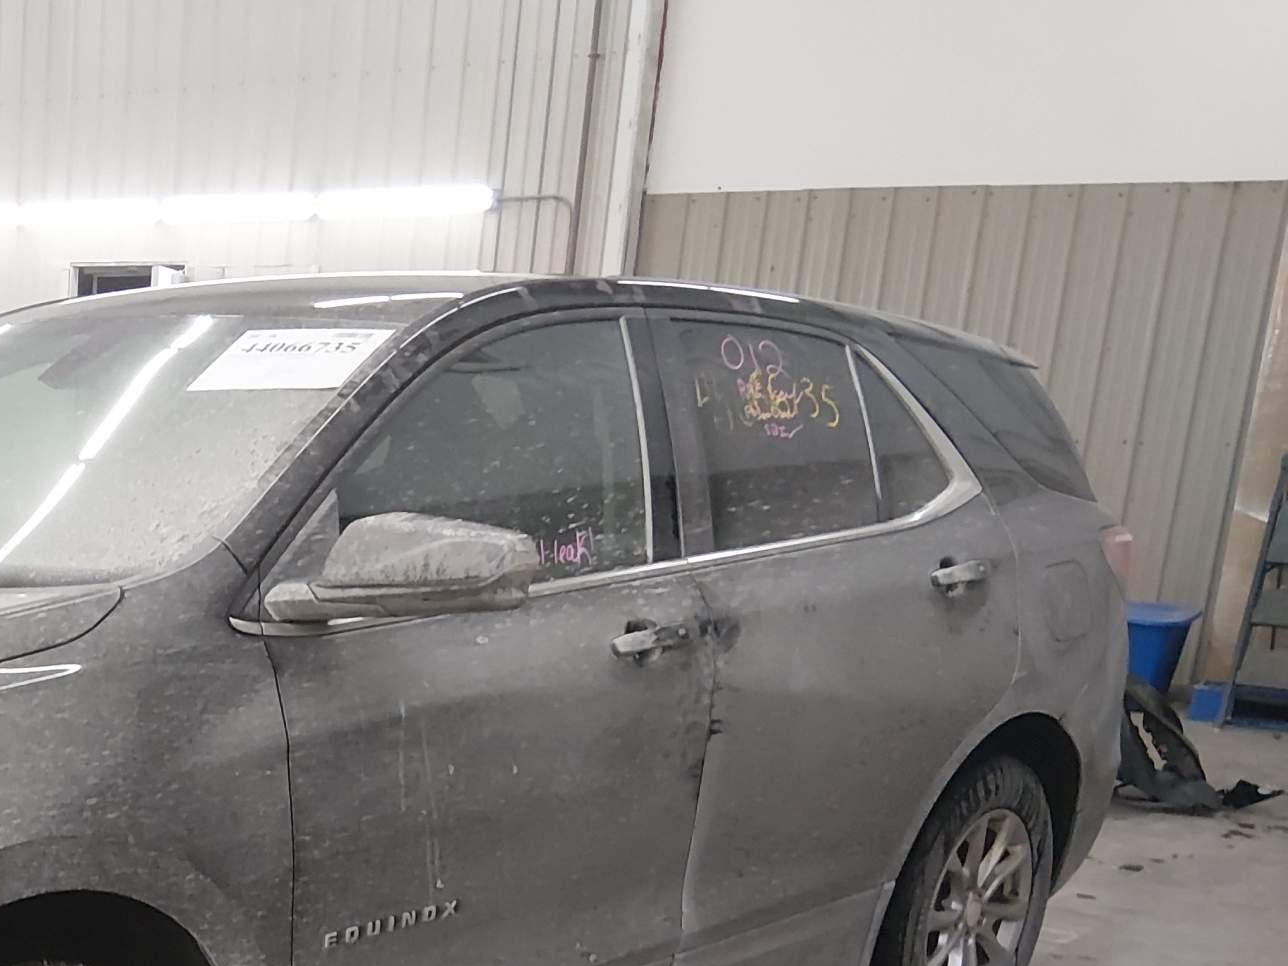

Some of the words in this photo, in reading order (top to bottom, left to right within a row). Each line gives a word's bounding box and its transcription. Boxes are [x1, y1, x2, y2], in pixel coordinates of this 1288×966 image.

[241, 341, 361, 353] 44066735
[720, 334, 792, 379] 012
[323, 899, 459, 949] EQUINOX
